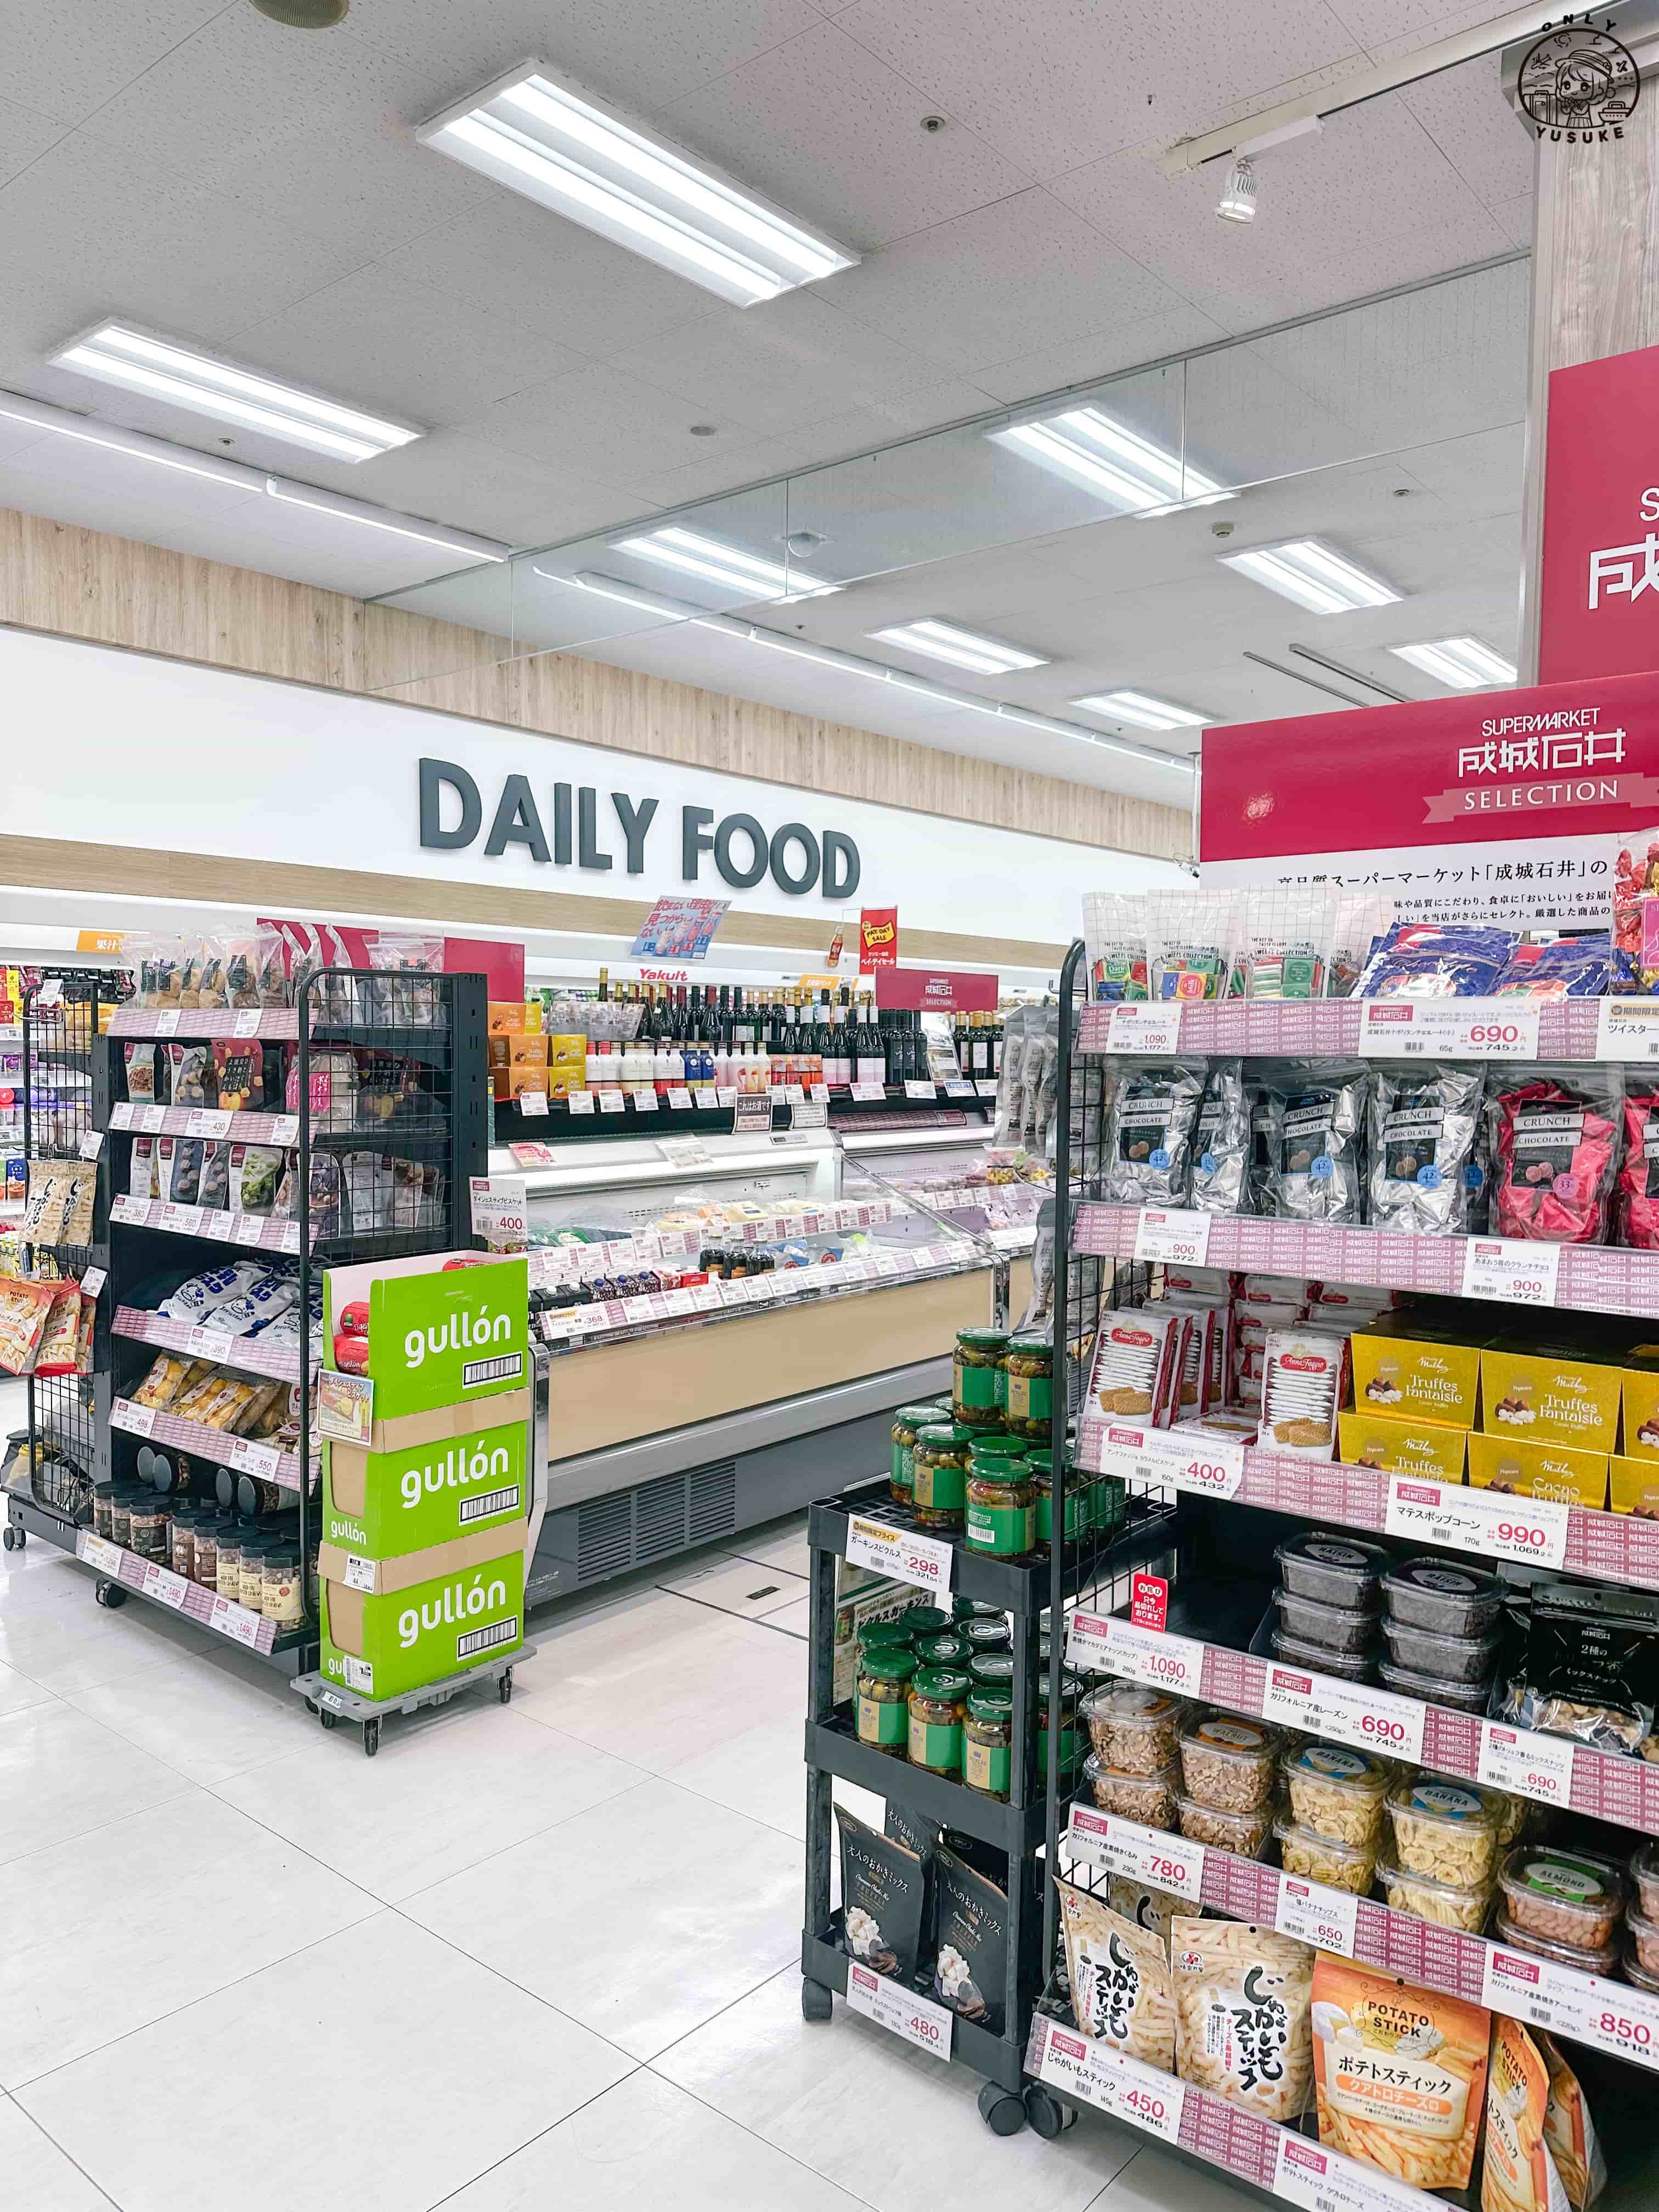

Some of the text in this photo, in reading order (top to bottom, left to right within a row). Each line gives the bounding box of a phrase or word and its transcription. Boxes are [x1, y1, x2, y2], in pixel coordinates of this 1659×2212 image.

[1481, 708, 1600, 737] SUPERMARKET
[1458, 728, 1626, 777] 成城石井
[1464, 780, 1618, 810] SELECTION
[419, 757, 861, 899] DAILY FOOD
[640, 969, 689, 981] Yakult
[1470, 1025, 1518, 1042] 690
[1439, 1045, 1453, 1053] 65g
[1128, 1100, 1163, 1110] CRUNCH
[1287, 1107, 1323, 1120] CRUNCH
[1125, 1116, 1163, 1125] CHOCOLATE
[1393, 1110, 1432, 1121] CRUNCH
[1523, 1116, 1571, 1128] CRUNCH
[1390, 1128, 1431, 1138] CHOCOLATE
[1518, 1135, 1570, 1144] CHOCOLATE
[500, 1217, 522, 1229] 400
[1173, 1244, 1195, 1255] 900
[1513, 1280, 1542, 1293] 900
[1513, 1292, 1542, 1300] 972
[405, 1305, 511, 1369] gullón
[1405, 1385, 1463, 1404] Fantaisie
[1545, 1394, 1598, 1414] Truffes
[1540, 1404, 1602, 1425] Fantaisie
[259, 1459, 272, 1471] 550
[400, 1440, 509, 1509] gullón
[1188, 1462, 1226, 1482] 400
[1199, 1481, 1224, 1491] 432
[1532, 1477, 1580, 1496] Cacao
[331, 1519, 366, 1545] gullón
[1464, 1536, 1480, 1546] 170g
[1498, 1523, 1545, 1547] 990
[1319, 1547, 1354, 1559] RAISIN
[909, 1556, 939, 1575] 298
[1426, 1573, 1463, 1587] RAISIN
[398, 1573, 506, 1649] gullón
[1122, 1665, 1136, 1675] 280g
[1149, 1655, 1186, 1679] 1,090
[1211, 1727, 1249, 1743] WALNUT
[1362, 1715, 1405, 1741] 690
[1317, 1750, 1355, 1769] BANANA
[1527, 1773, 1556, 1790] 690
[1425, 1789, 1469, 1807] BANANA
[847, 1844, 909, 1893] 大人のおかきミックス
[1122, 1864, 1136, 1875] 230g
[1150, 1855, 1186, 1881] 780
[1540, 1870, 1585, 1889] ALMOND
[1318, 1925, 1342, 1941] 650
[1319, 1937, 1341, 1948] 702
[1244, 1966, 1286, 2081] じゃがいも
[1368, 2001, 1429, 2027] POTATO
[911, 2016, 939, 2040] 480
[1373, 2017, 1421, 2038] STICK
[1600, 2012, 1651, 2045] 850
[1048, 2052, 1115, 2091] じゃがいもスティック
[1501, 2040, 1528, 2086] POTATO
[1339, 2056, 1452, 2095] ポテトスティック
[1500, 2058, 1521, 2095] STICK
[1126, 2089, 1164, 2118] 450
[1137, 2113, 1163, 2128] 486
